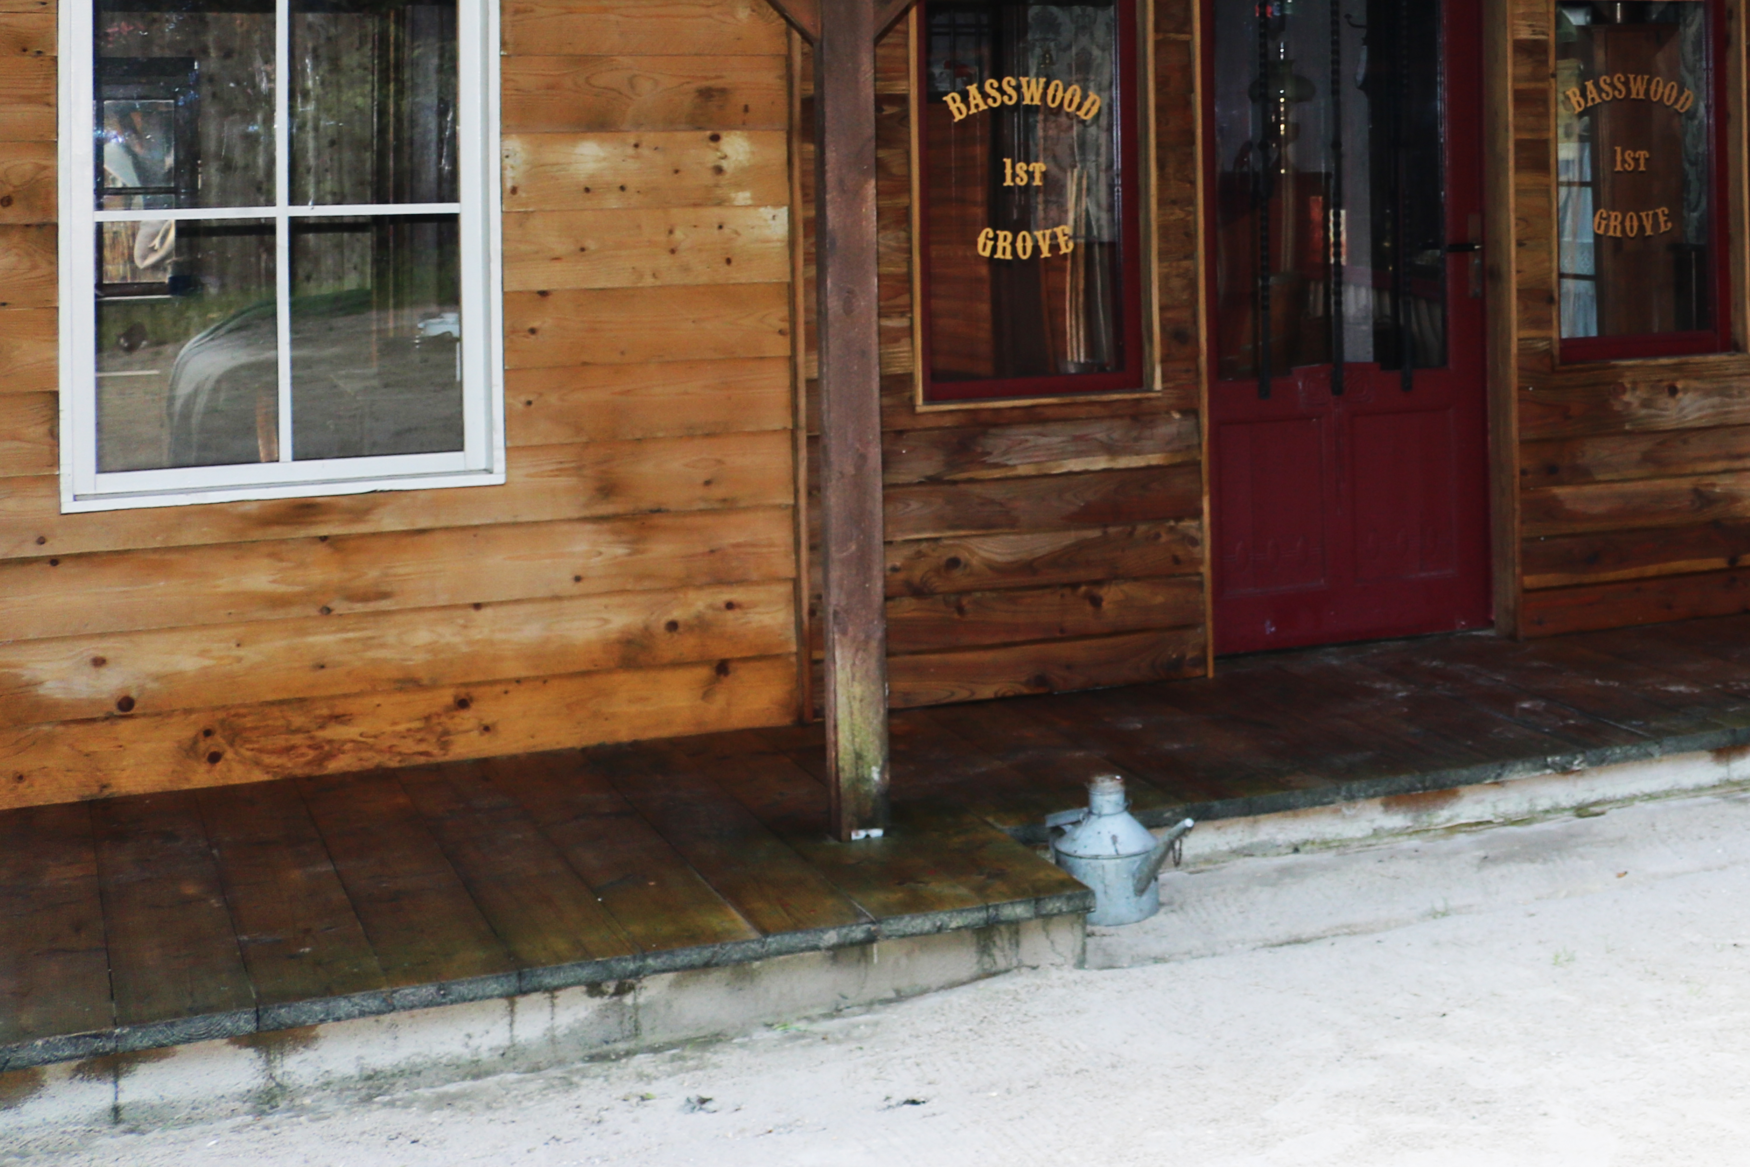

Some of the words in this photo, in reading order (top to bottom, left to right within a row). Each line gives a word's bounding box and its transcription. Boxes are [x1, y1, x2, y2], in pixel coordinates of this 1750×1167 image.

[943, 77, 1102, 123] BASSWOOD
[1566, 73, 1694, 115] BASSWOOD
[1593, 206, 1672, 238] GROVE
[977, 224, 1074, 260] GROVE
